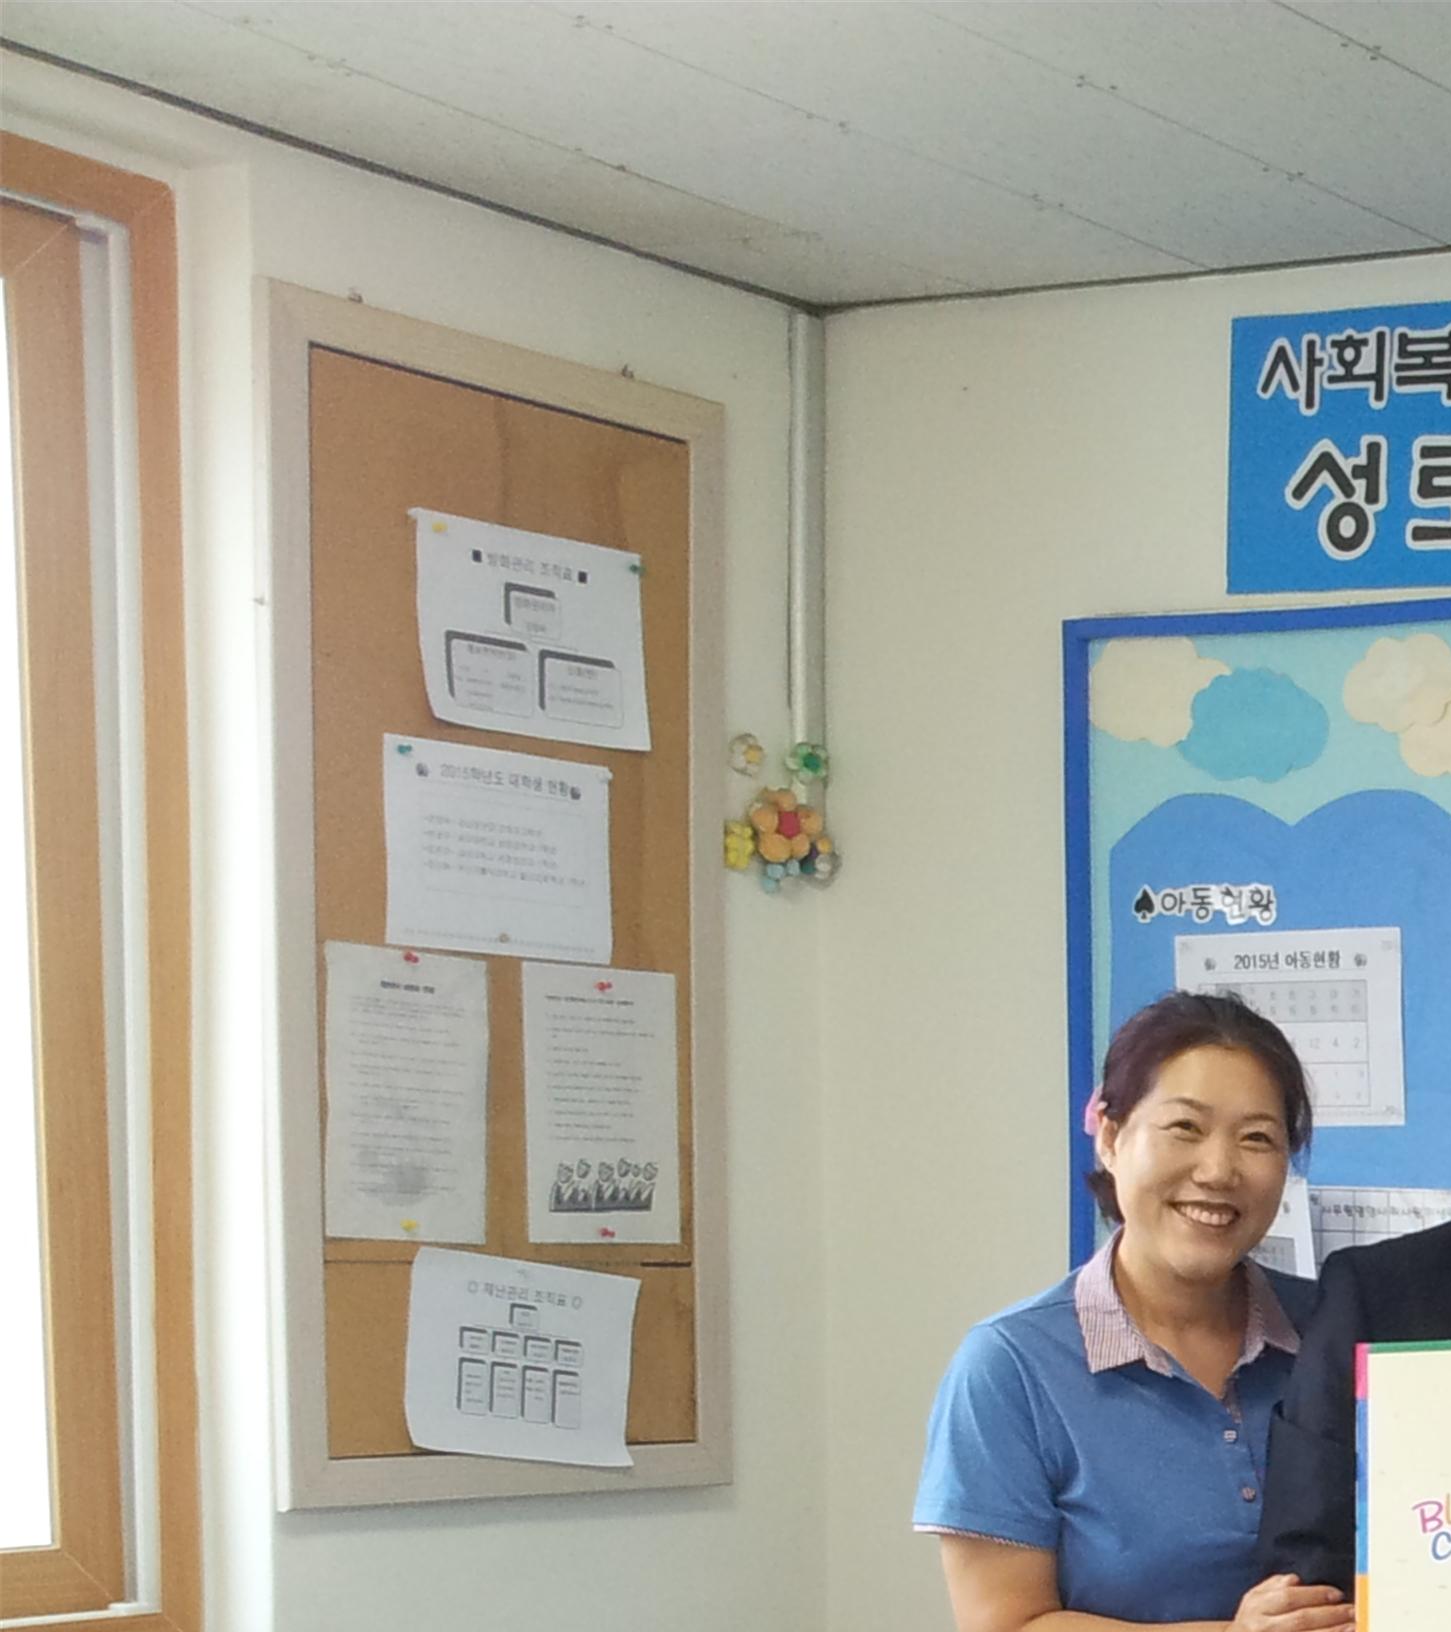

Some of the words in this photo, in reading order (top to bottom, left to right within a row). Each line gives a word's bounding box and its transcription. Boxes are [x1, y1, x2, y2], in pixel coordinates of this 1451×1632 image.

[1161, 886, 1276, 920] 아동현황
[1233, 953, 1280, 970] 2015년
[1285, 950, 1341, 969] 아동현황
